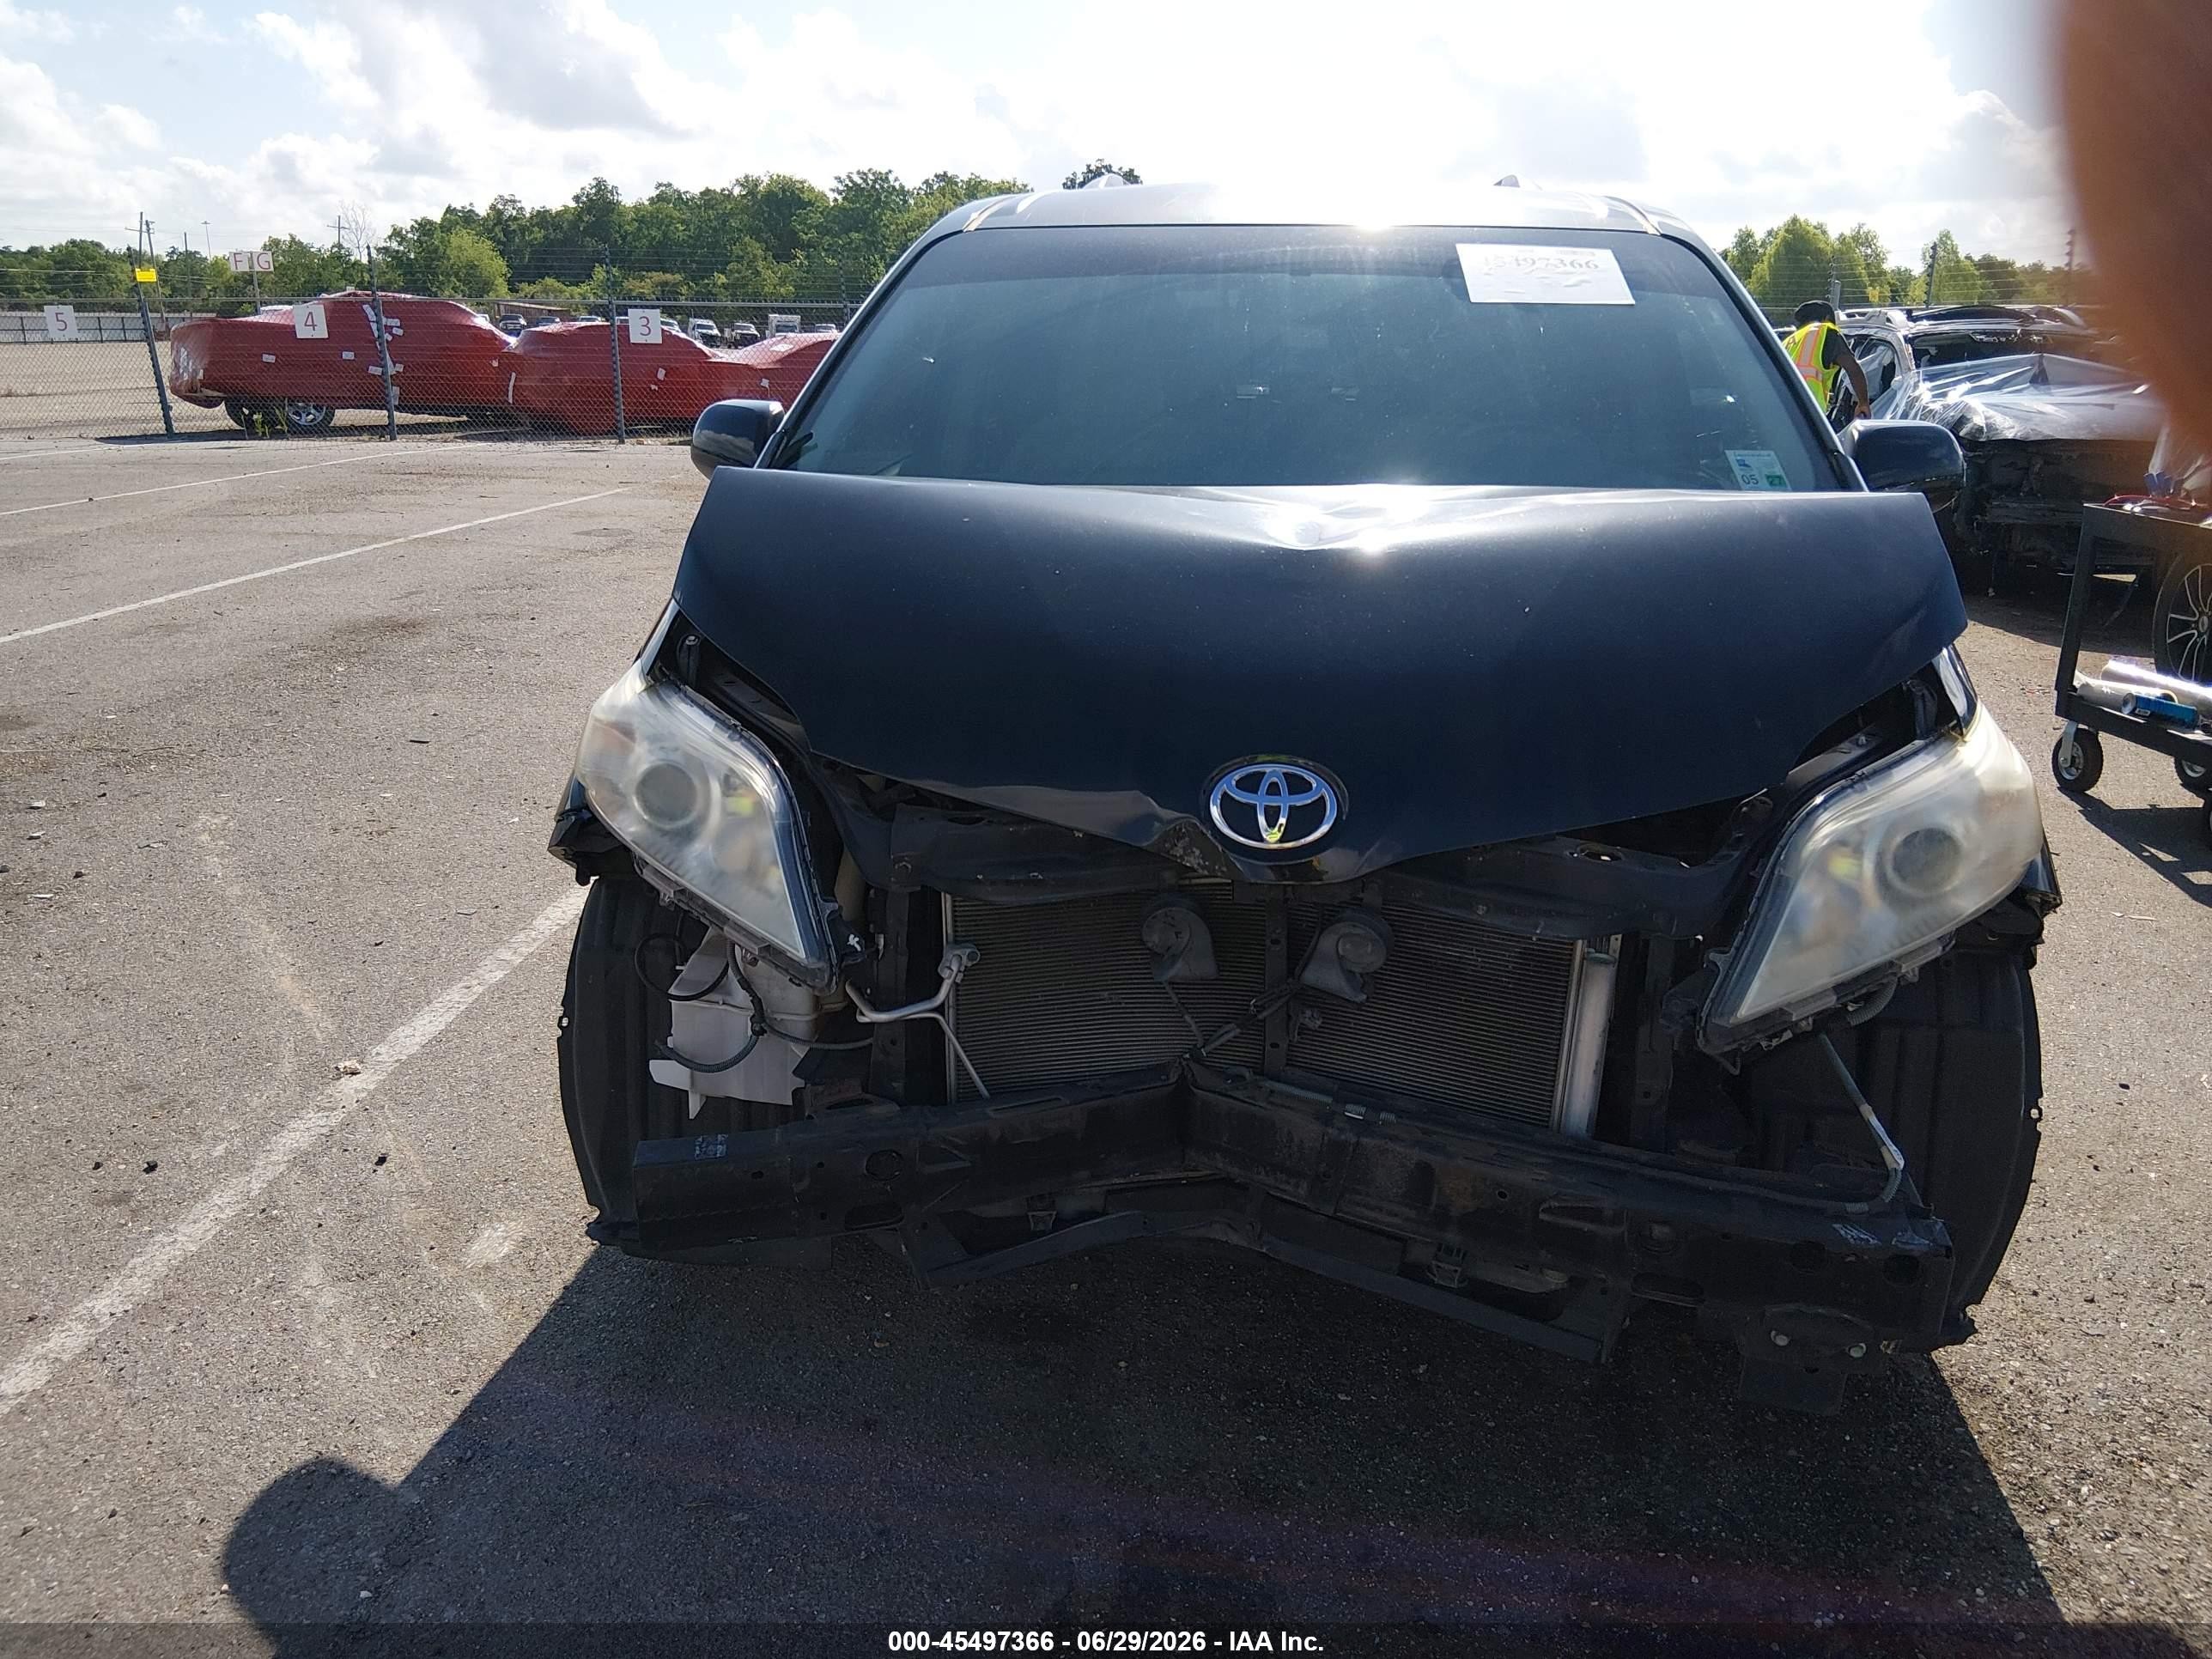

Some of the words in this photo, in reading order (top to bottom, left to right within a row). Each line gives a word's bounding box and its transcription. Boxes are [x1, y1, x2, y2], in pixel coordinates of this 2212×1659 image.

[234, 252, 243, 270] F
[257, 252, 270, 270] G
[55, 312, 67, 331] 5
[304, 311, 318, 331] 4
[639, 315, 652, 337] 3
[1741, 474, 1759, 485] 05
